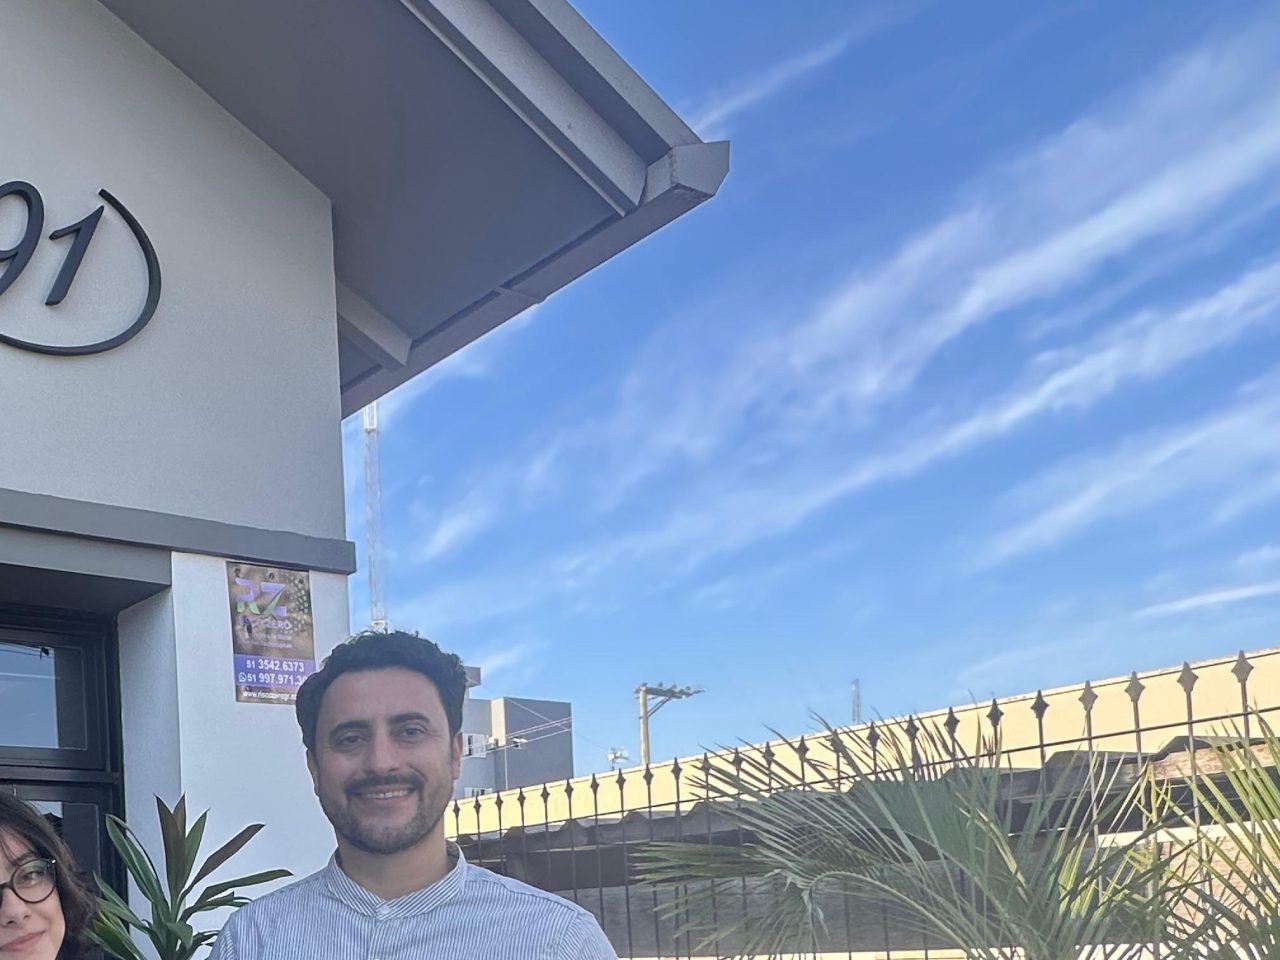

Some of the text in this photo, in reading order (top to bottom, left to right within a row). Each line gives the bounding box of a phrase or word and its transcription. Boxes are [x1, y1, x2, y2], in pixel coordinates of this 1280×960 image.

[246, 659, 305, 672] 51 3542.6373
[247, 673, 257, 683] 51
